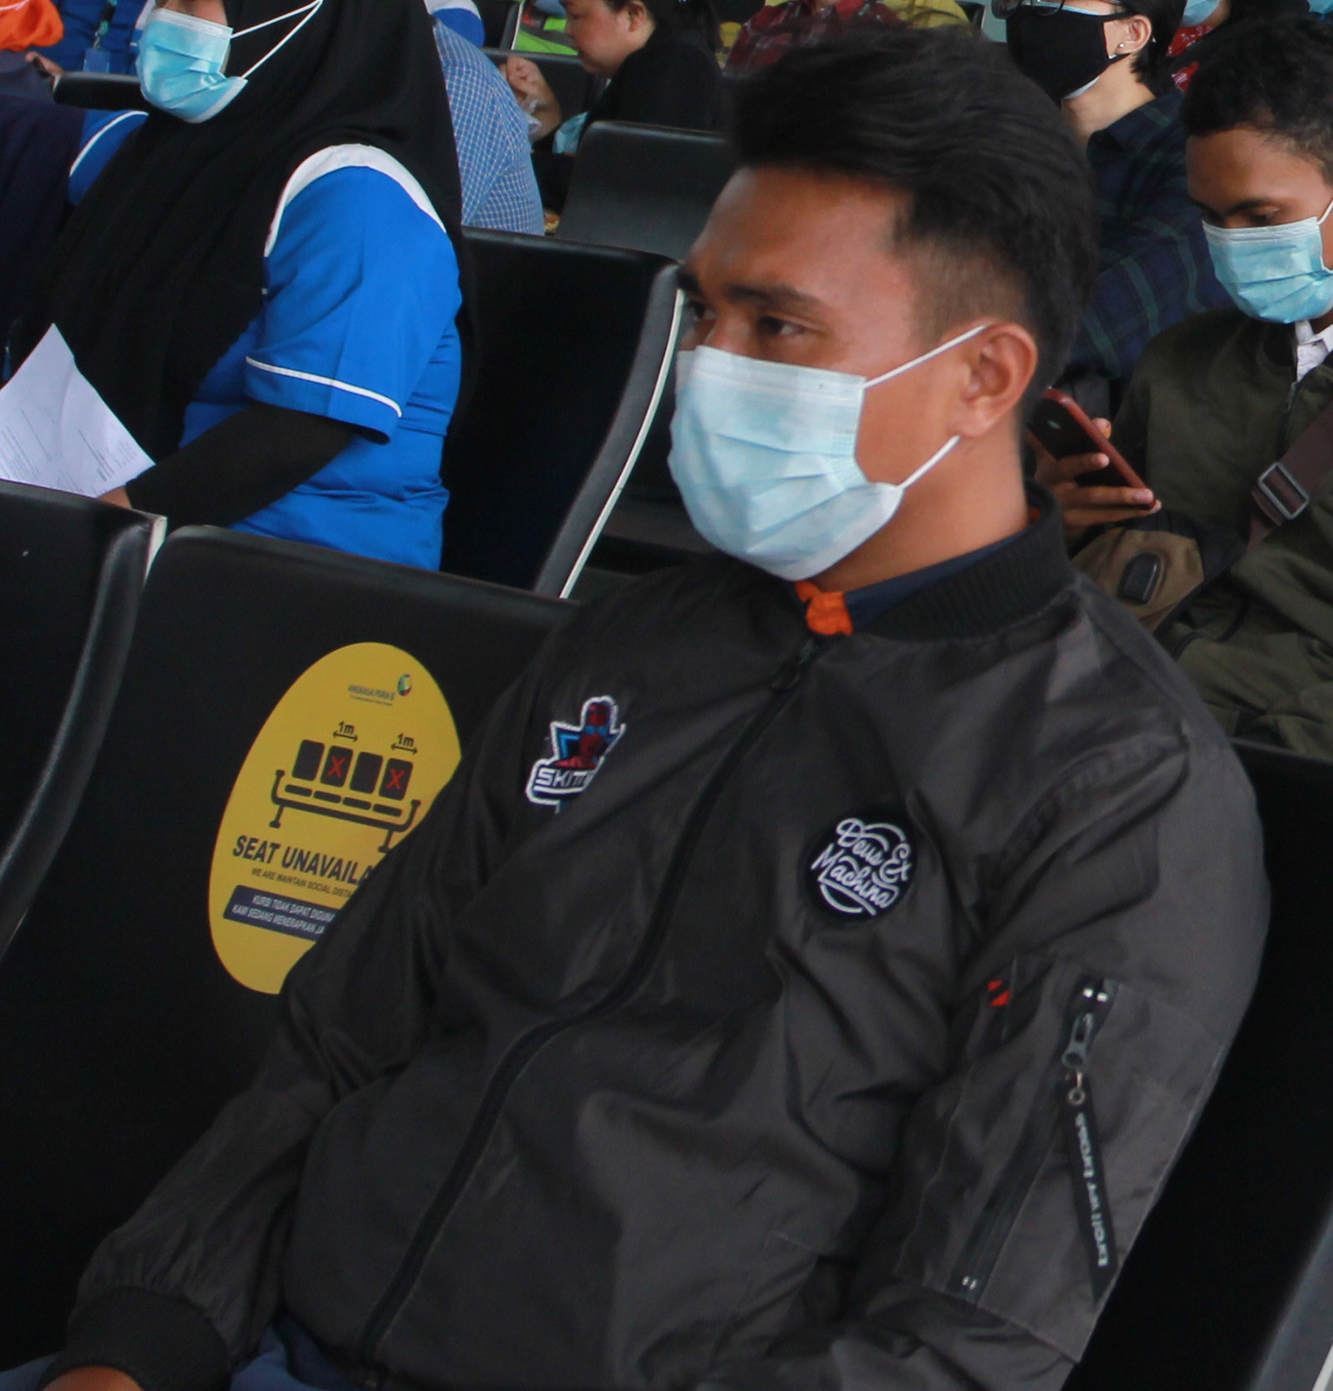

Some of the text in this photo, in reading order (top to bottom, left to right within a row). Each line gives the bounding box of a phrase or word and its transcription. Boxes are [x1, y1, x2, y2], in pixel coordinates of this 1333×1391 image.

[338, 720, 355, 735] 1m
[397, 732, 414, 748] 1m
[233, 835, 281, 864] SEAT
[836, 818, 891, 866] Deus
[810, 843, 899, 909] Machina
